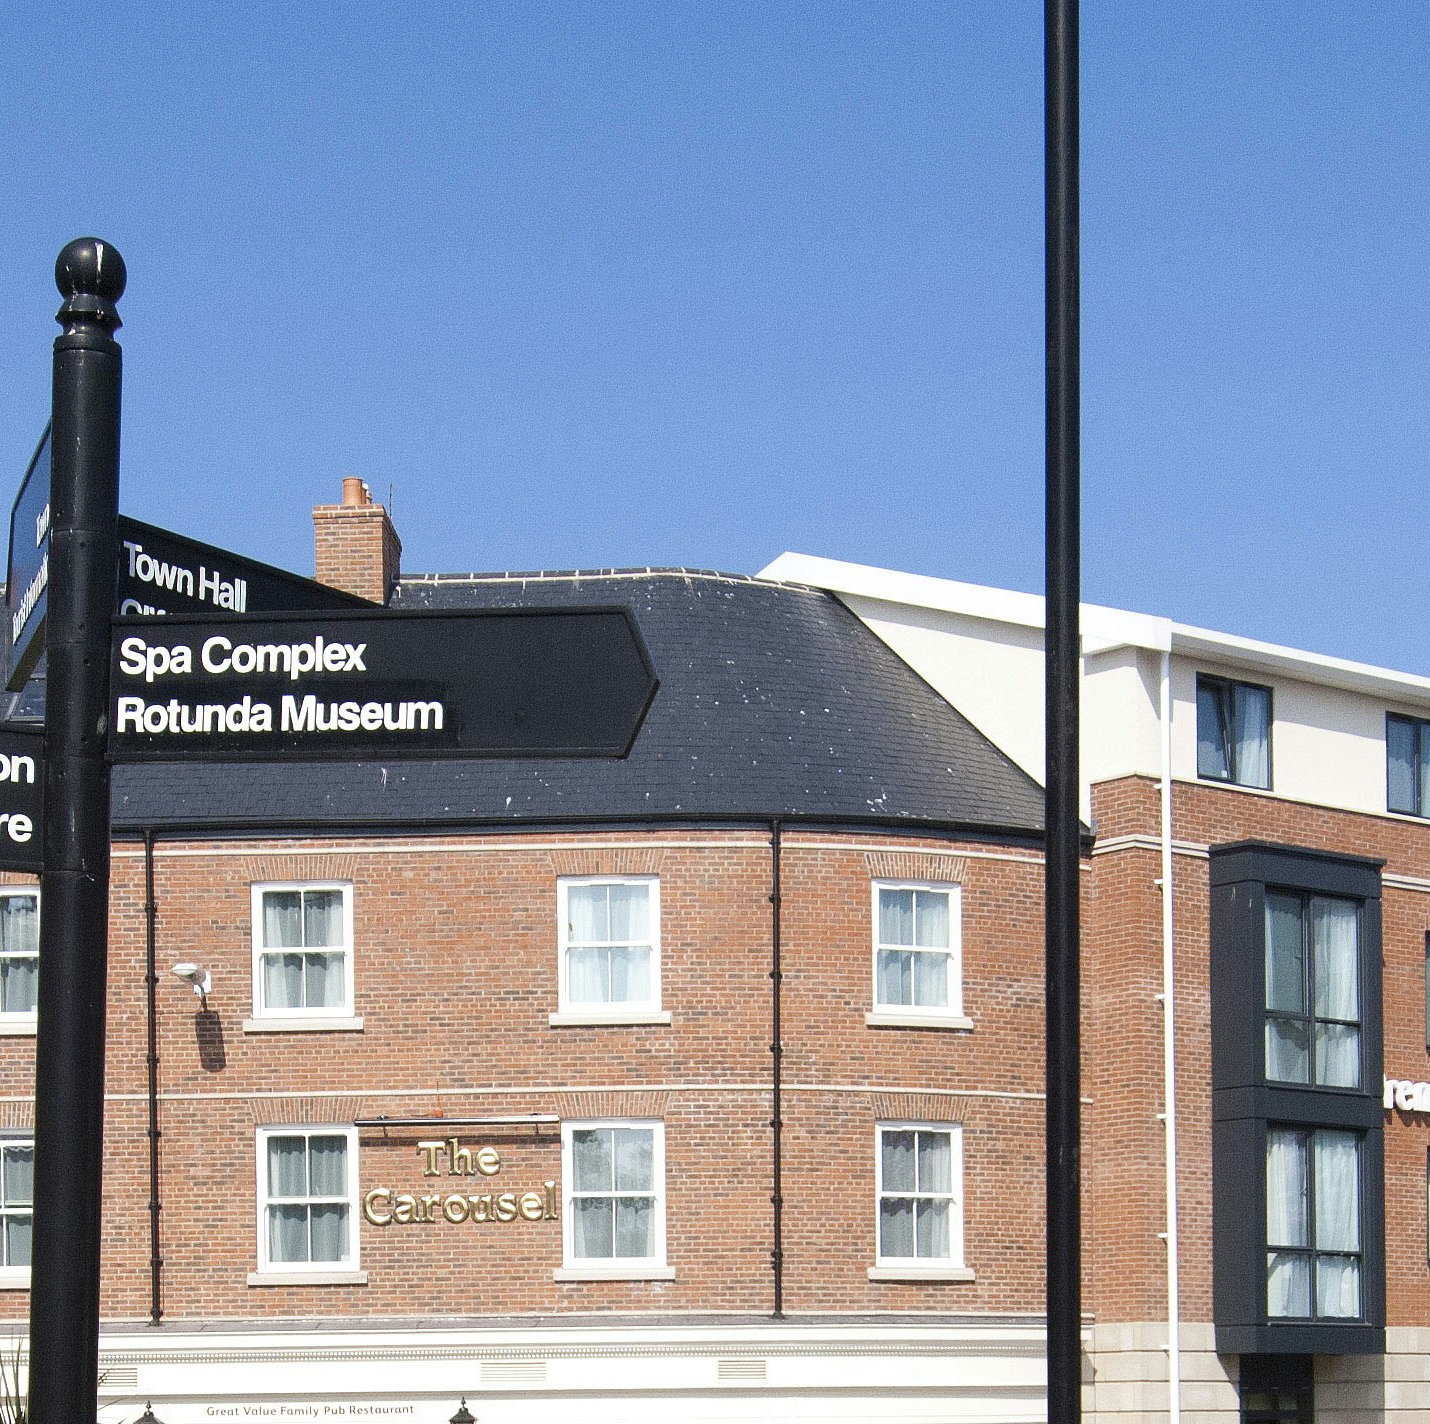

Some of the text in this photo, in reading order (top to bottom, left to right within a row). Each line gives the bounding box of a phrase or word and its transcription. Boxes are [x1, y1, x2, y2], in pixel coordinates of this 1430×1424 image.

[123, 540, 246, 613] Town Hall
[120, 635, 367, 683] Spa Complex
[117, 694, 443, 733] Rotunda Museum
[416, 1137, 502, 1177] The
[362, 1180, 558, 1227] Carousel
[206, 1405, 415, 1418] Great Value Family Pub Restaurant
